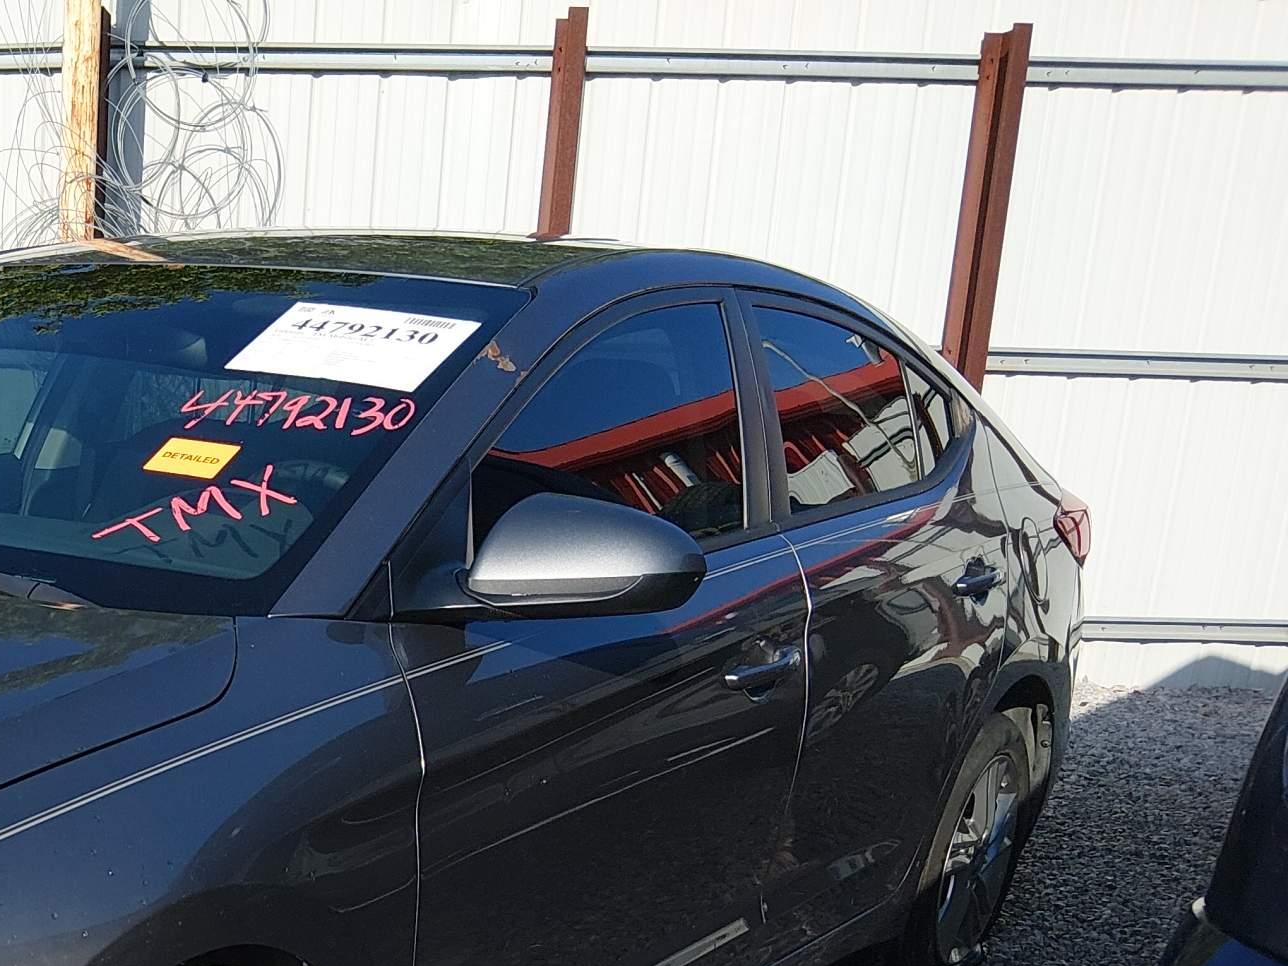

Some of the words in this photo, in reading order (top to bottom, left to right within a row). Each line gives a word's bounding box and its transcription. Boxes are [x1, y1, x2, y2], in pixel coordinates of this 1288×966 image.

[291, 318, 440, 345] 44792130
[180, 389, 416, 436] 44792130
[162, 451, 220, 466] DETAILED
[92, 464, 297, 543] TMX
